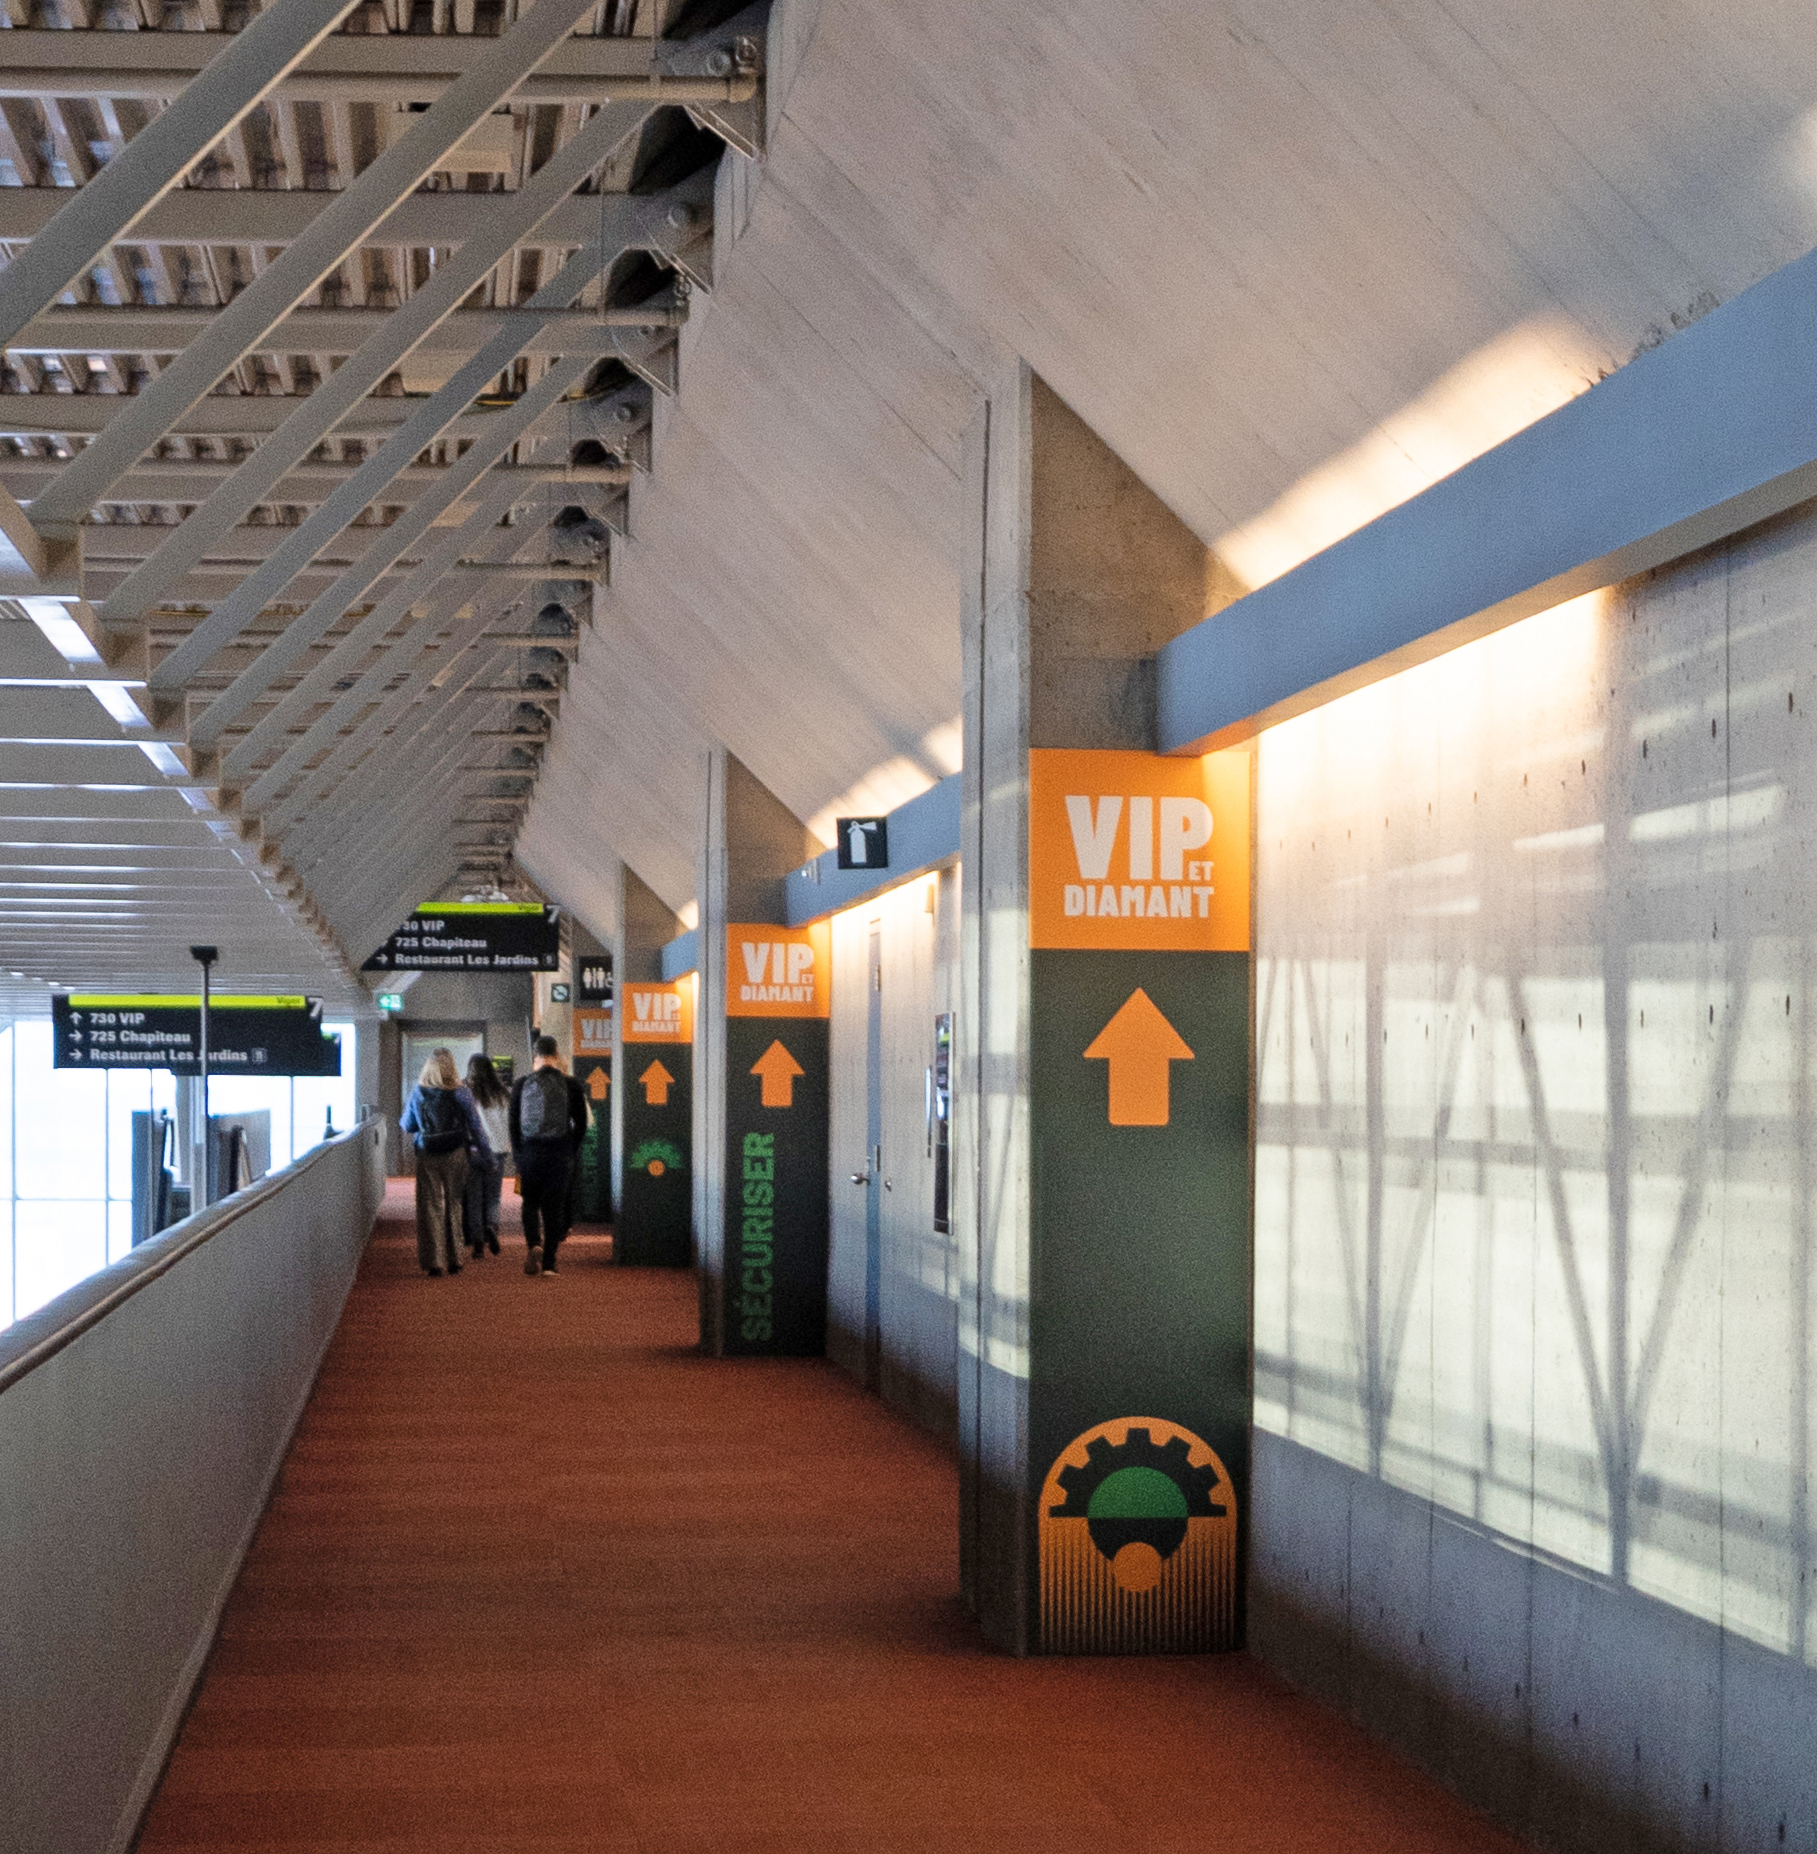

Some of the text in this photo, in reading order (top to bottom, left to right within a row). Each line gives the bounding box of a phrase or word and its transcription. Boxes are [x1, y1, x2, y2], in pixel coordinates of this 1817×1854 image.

[1064, 795, 1214, 881] VIP
[1188, 861, 1214, 881] ET
[1063, 885, 1215, 918] DIAMANT
[402, 920, 445, 931] 30 VIP
[422, 936, 487, 949] Chapiteau
[395, 953, 539, 966] Restaurant Les Jardins
[741, 942, 815, 983] VIP
[740, 985, 814, 1002] DIAMANT
[307, 997, 324, 1018] 7
[632, 992, 682, 1020] VIP
[90, 1013, 145, 1025] 730 VIP
[90, 1030, 191, 1046] 725 Chapiteau
[90, 1048, 166, 1061] Restaurant
[169, 1049, 194, 1061] Les
